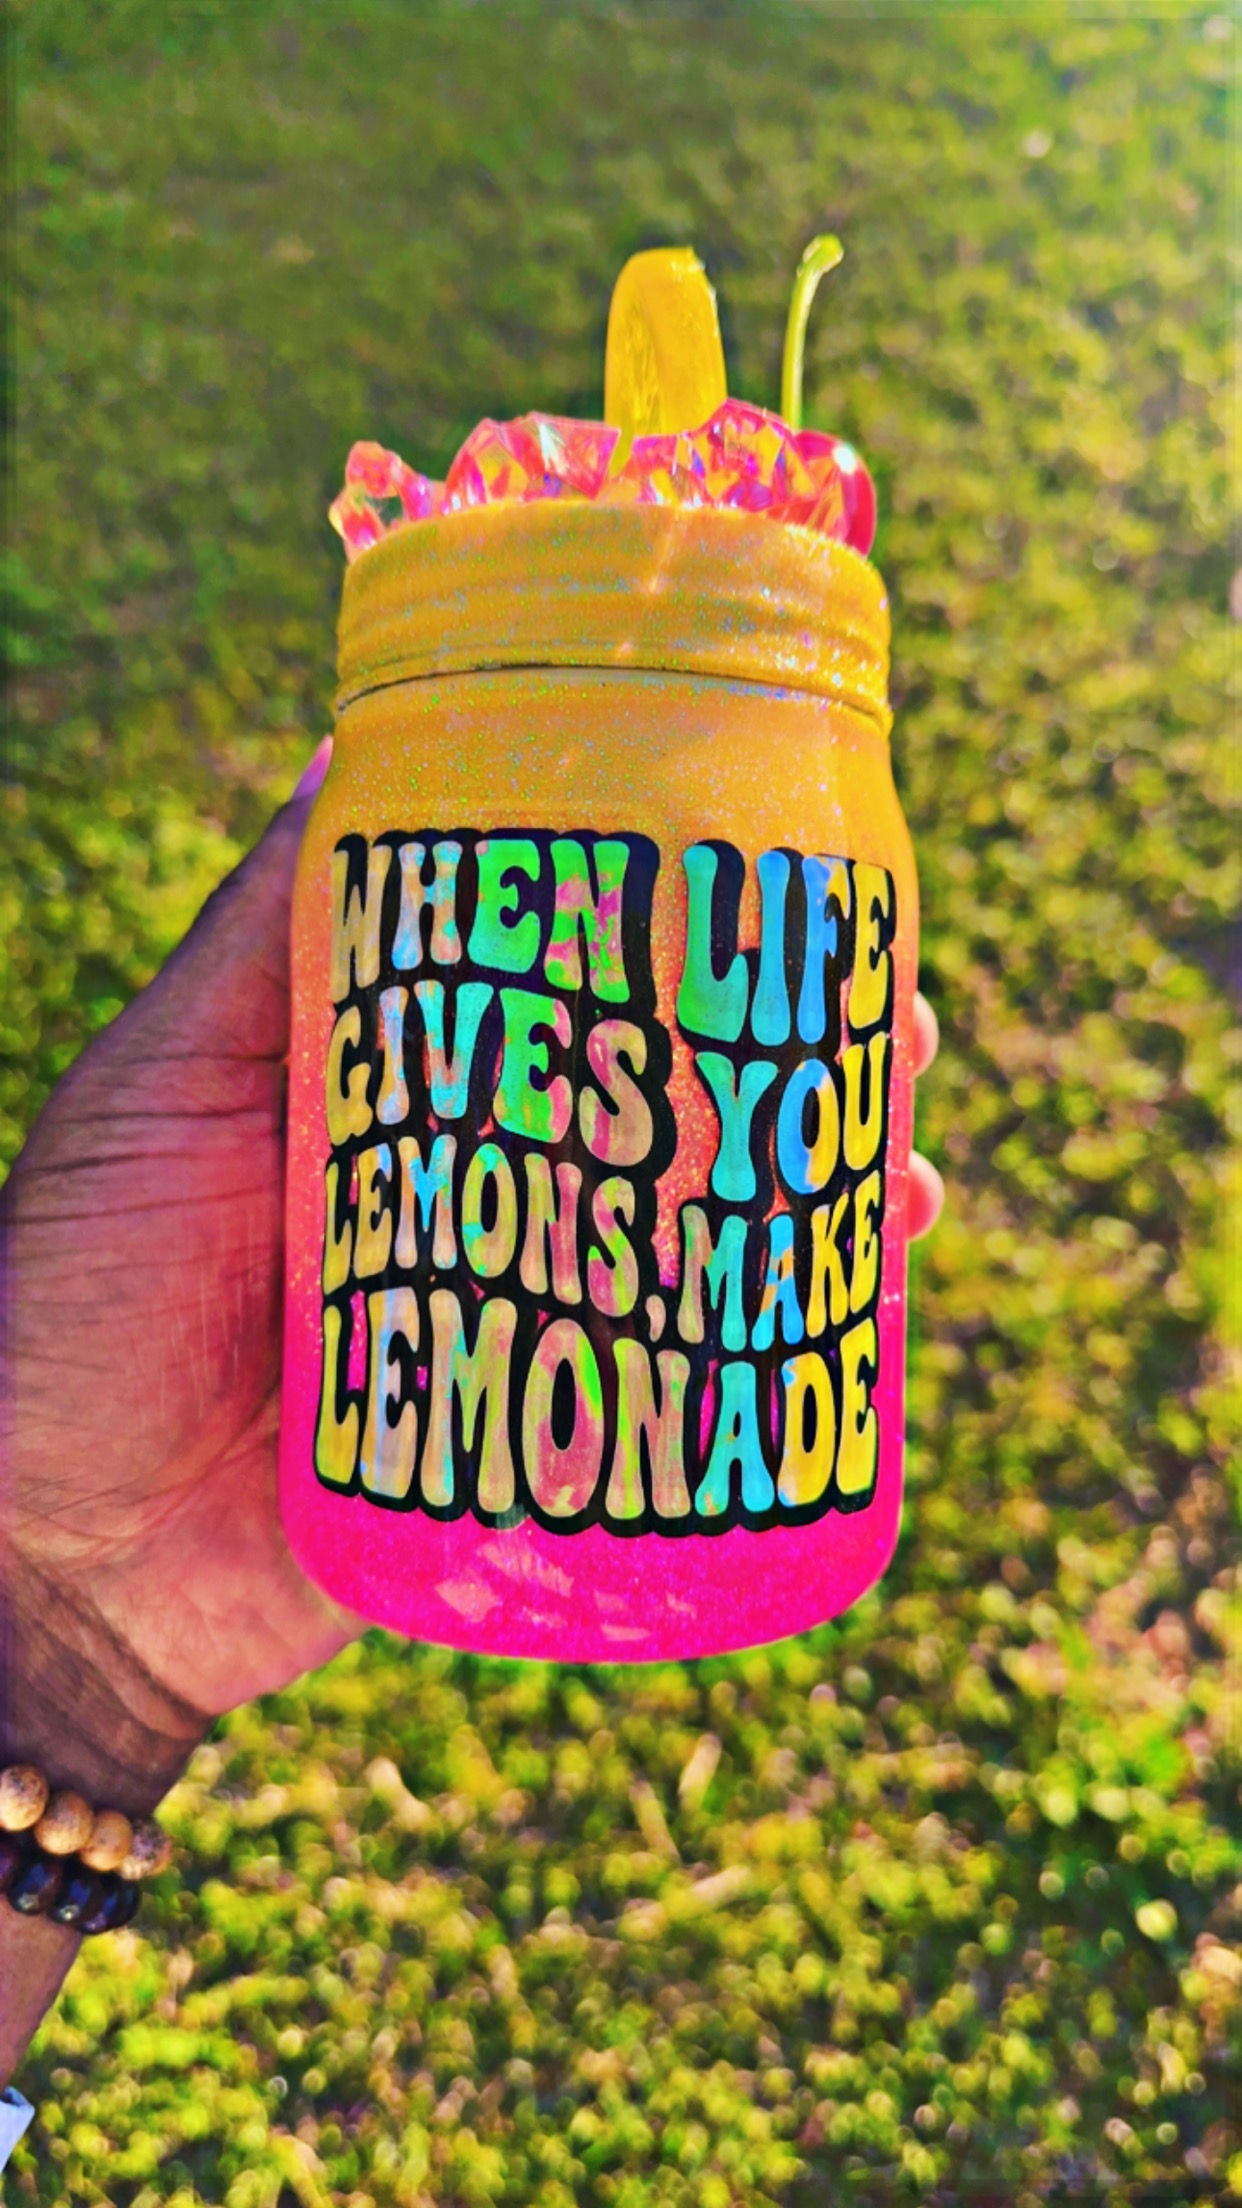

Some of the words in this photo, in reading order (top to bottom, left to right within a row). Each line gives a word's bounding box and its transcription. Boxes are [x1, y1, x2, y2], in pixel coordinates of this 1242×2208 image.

[332, 838, 631, 1005] WHEN
[677, 843, 890, 1047] LIFE
[325, 979, 653, 1168] GIVES
[695, 1030, 887, 1202] YOU
[322, 1133, 666, 1343] LEMONS,
[677, 1170, 881, 1352] MAKE
[318, 1286, 878, 1521] LEMONADE
